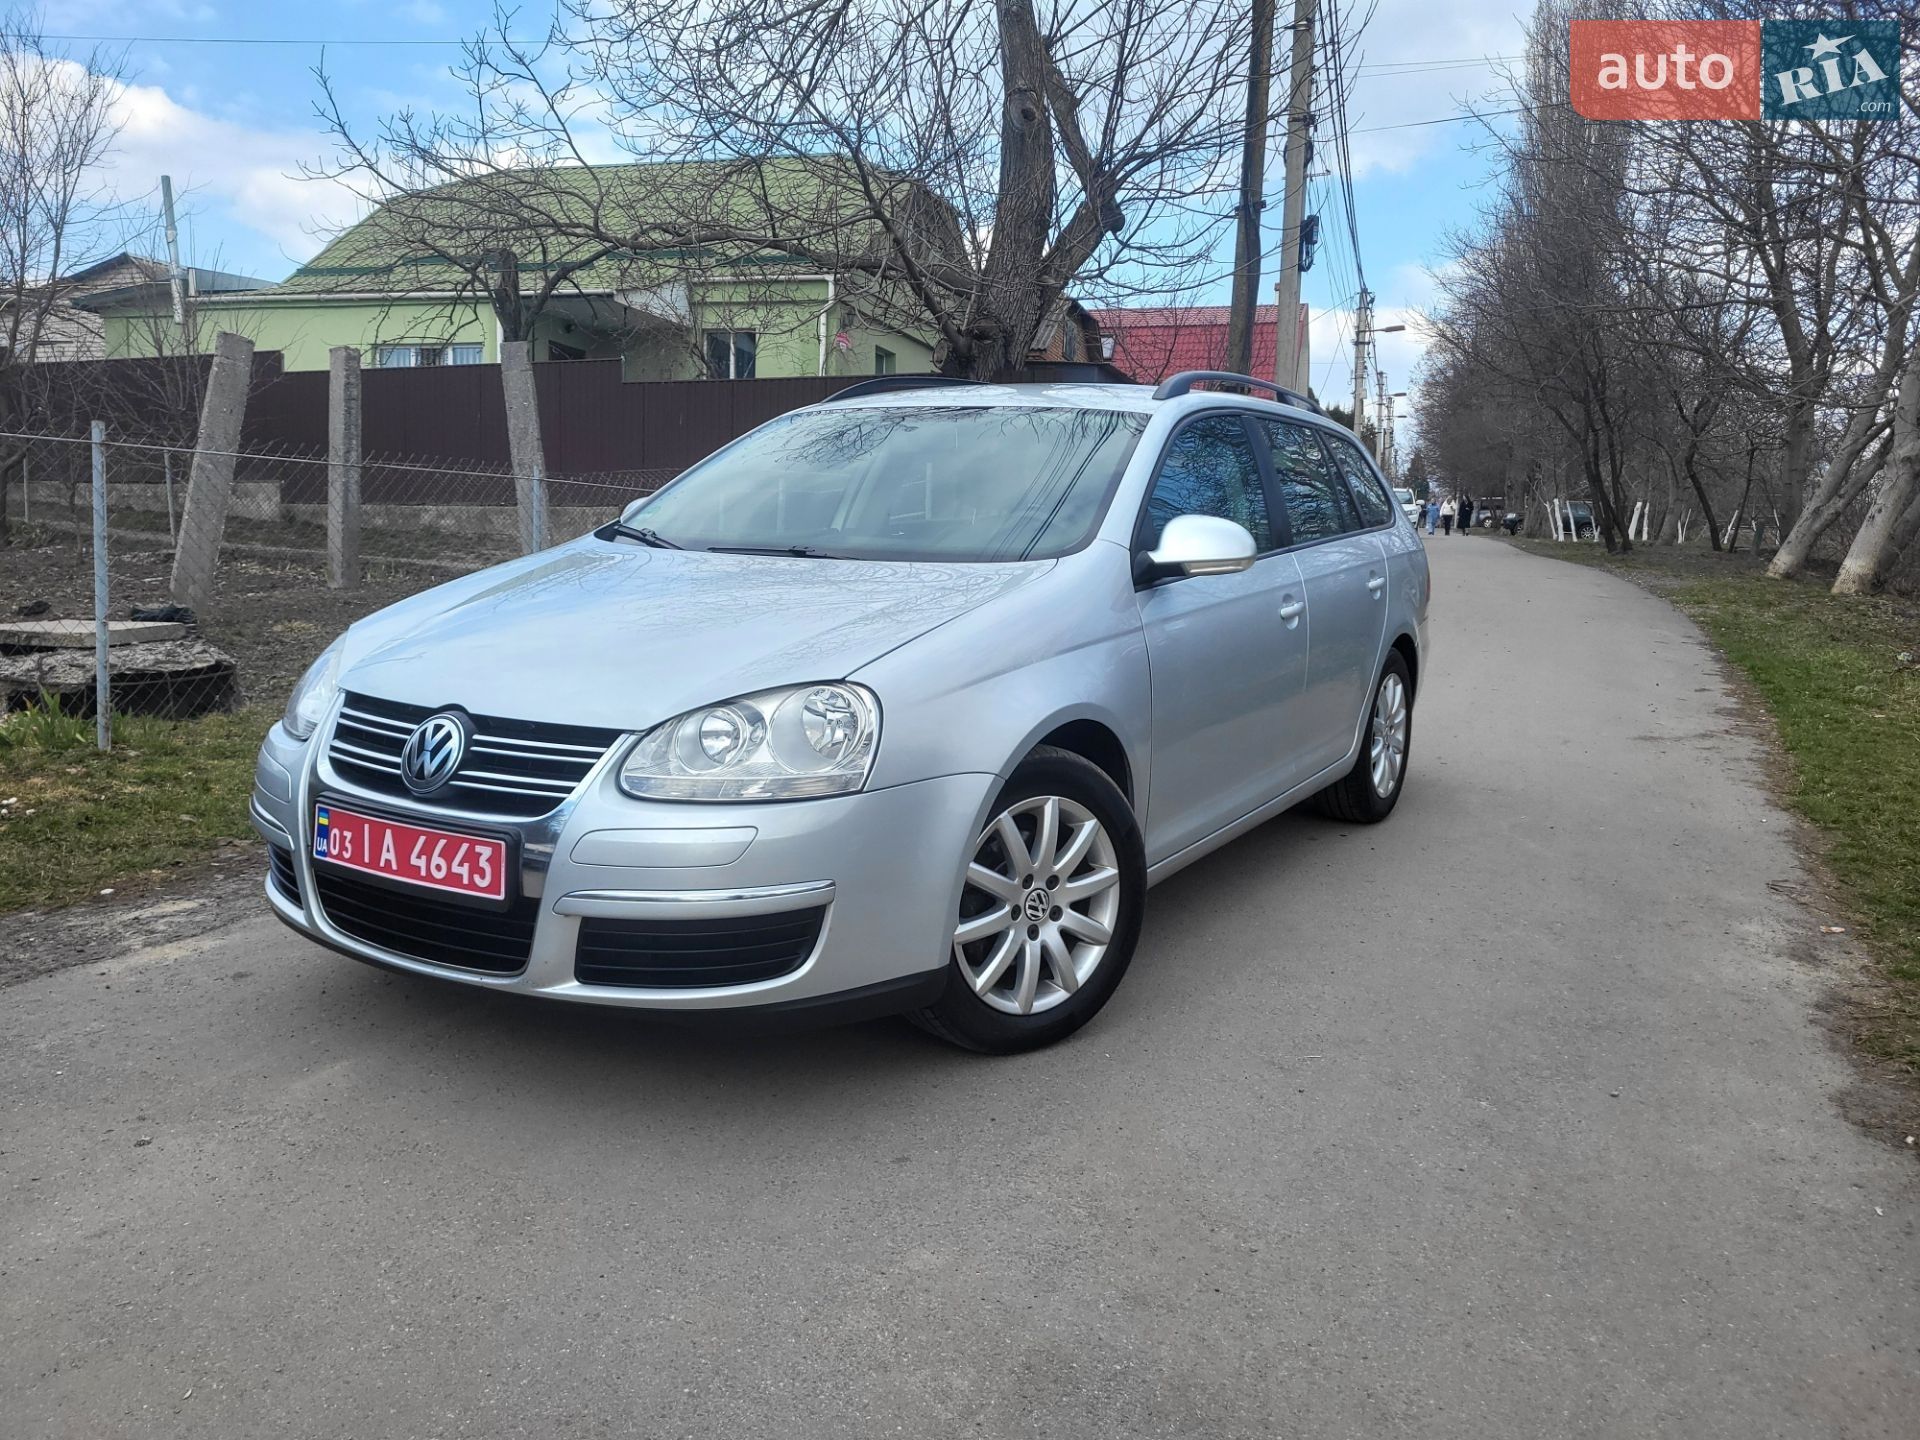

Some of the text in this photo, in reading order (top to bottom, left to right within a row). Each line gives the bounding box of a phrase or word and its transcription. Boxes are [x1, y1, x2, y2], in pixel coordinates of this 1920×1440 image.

[405, 718, 460, 782] VW
[316, 836, 328, 852] UA
[329, 823, 493, 888] 03 IA 4643
